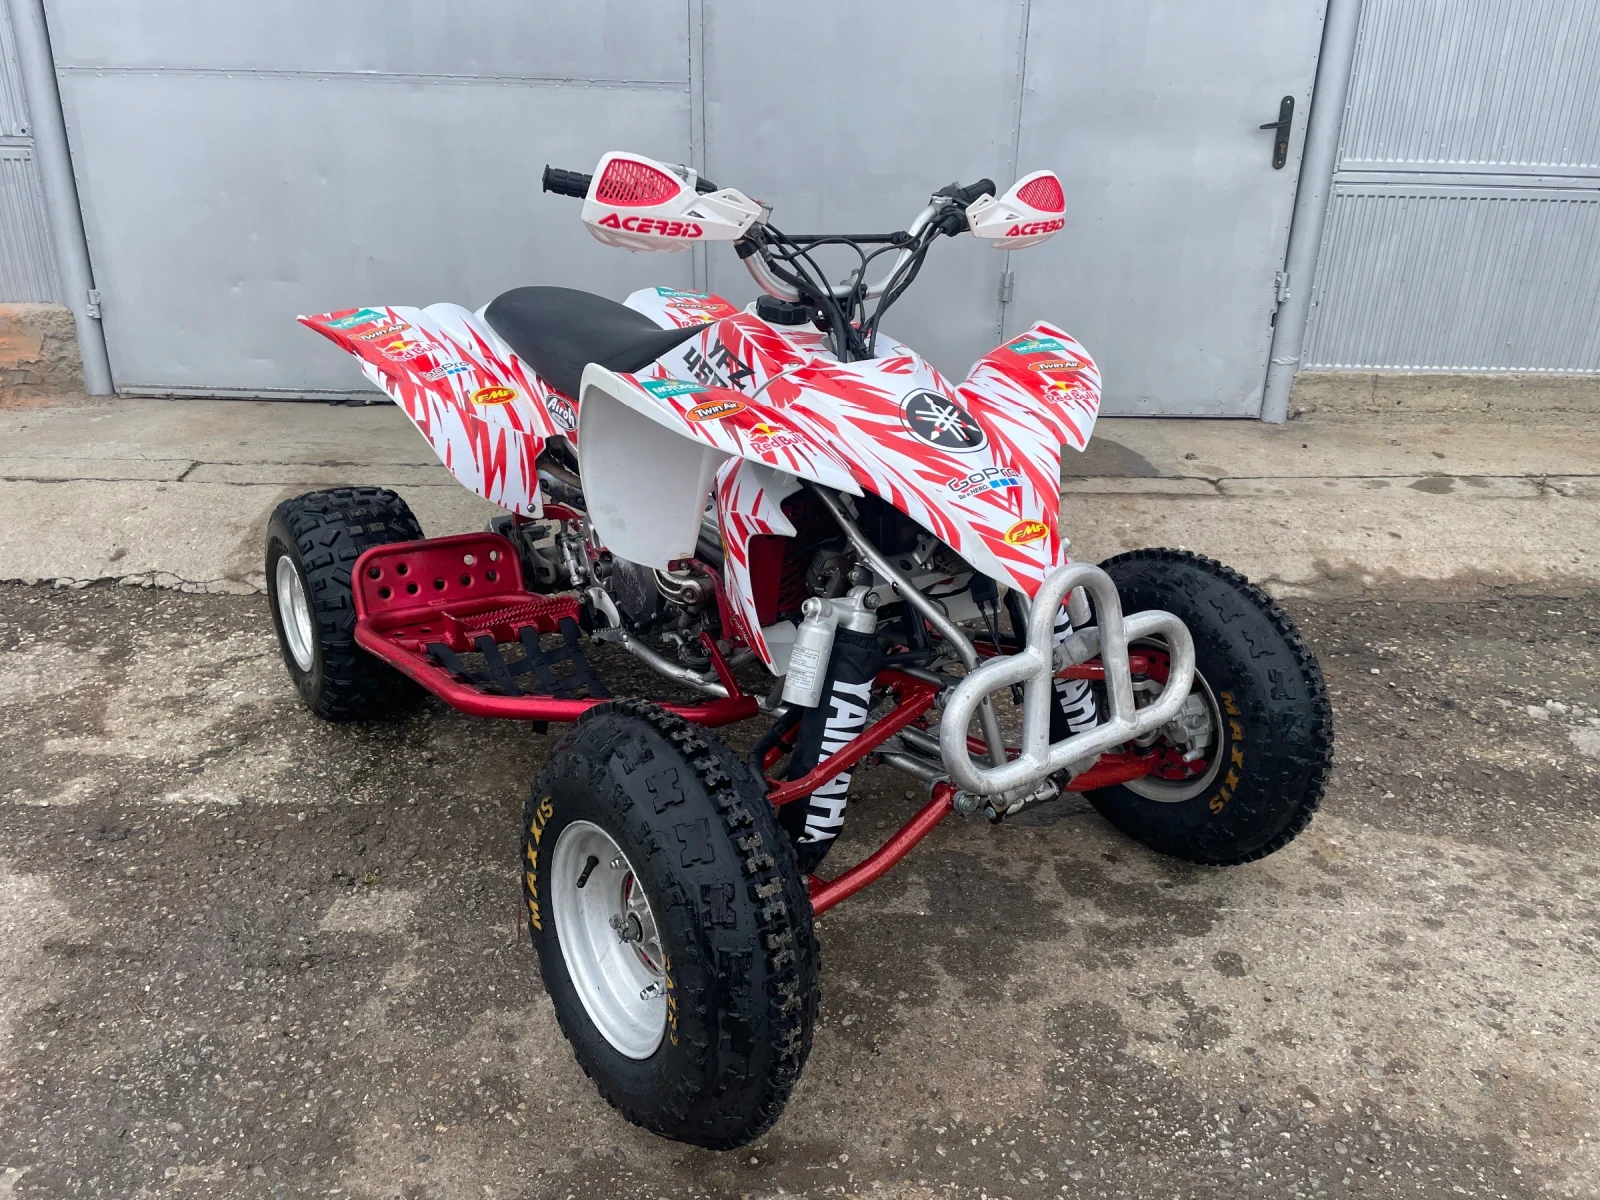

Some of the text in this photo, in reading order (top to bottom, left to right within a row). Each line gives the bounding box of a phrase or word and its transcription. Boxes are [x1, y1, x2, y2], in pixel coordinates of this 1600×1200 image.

[598, 213, 703, 238] ACERBIS
[1039, 363, 1063, 371] Twin
[1045, 389, 1098, 403] Red Bull
[548, 397, 575, 428] Airoh
[693, 402, 739, 420] Twin Air
[750, 432, 807, 454] Red Bull
[948, 467, 1019, 492] GoPro
[1011, 523, 1045, 542] FMF
[1209, 691, 1244, 815] MAXXIS
[527, 796, 554, 932] MAXXIS
